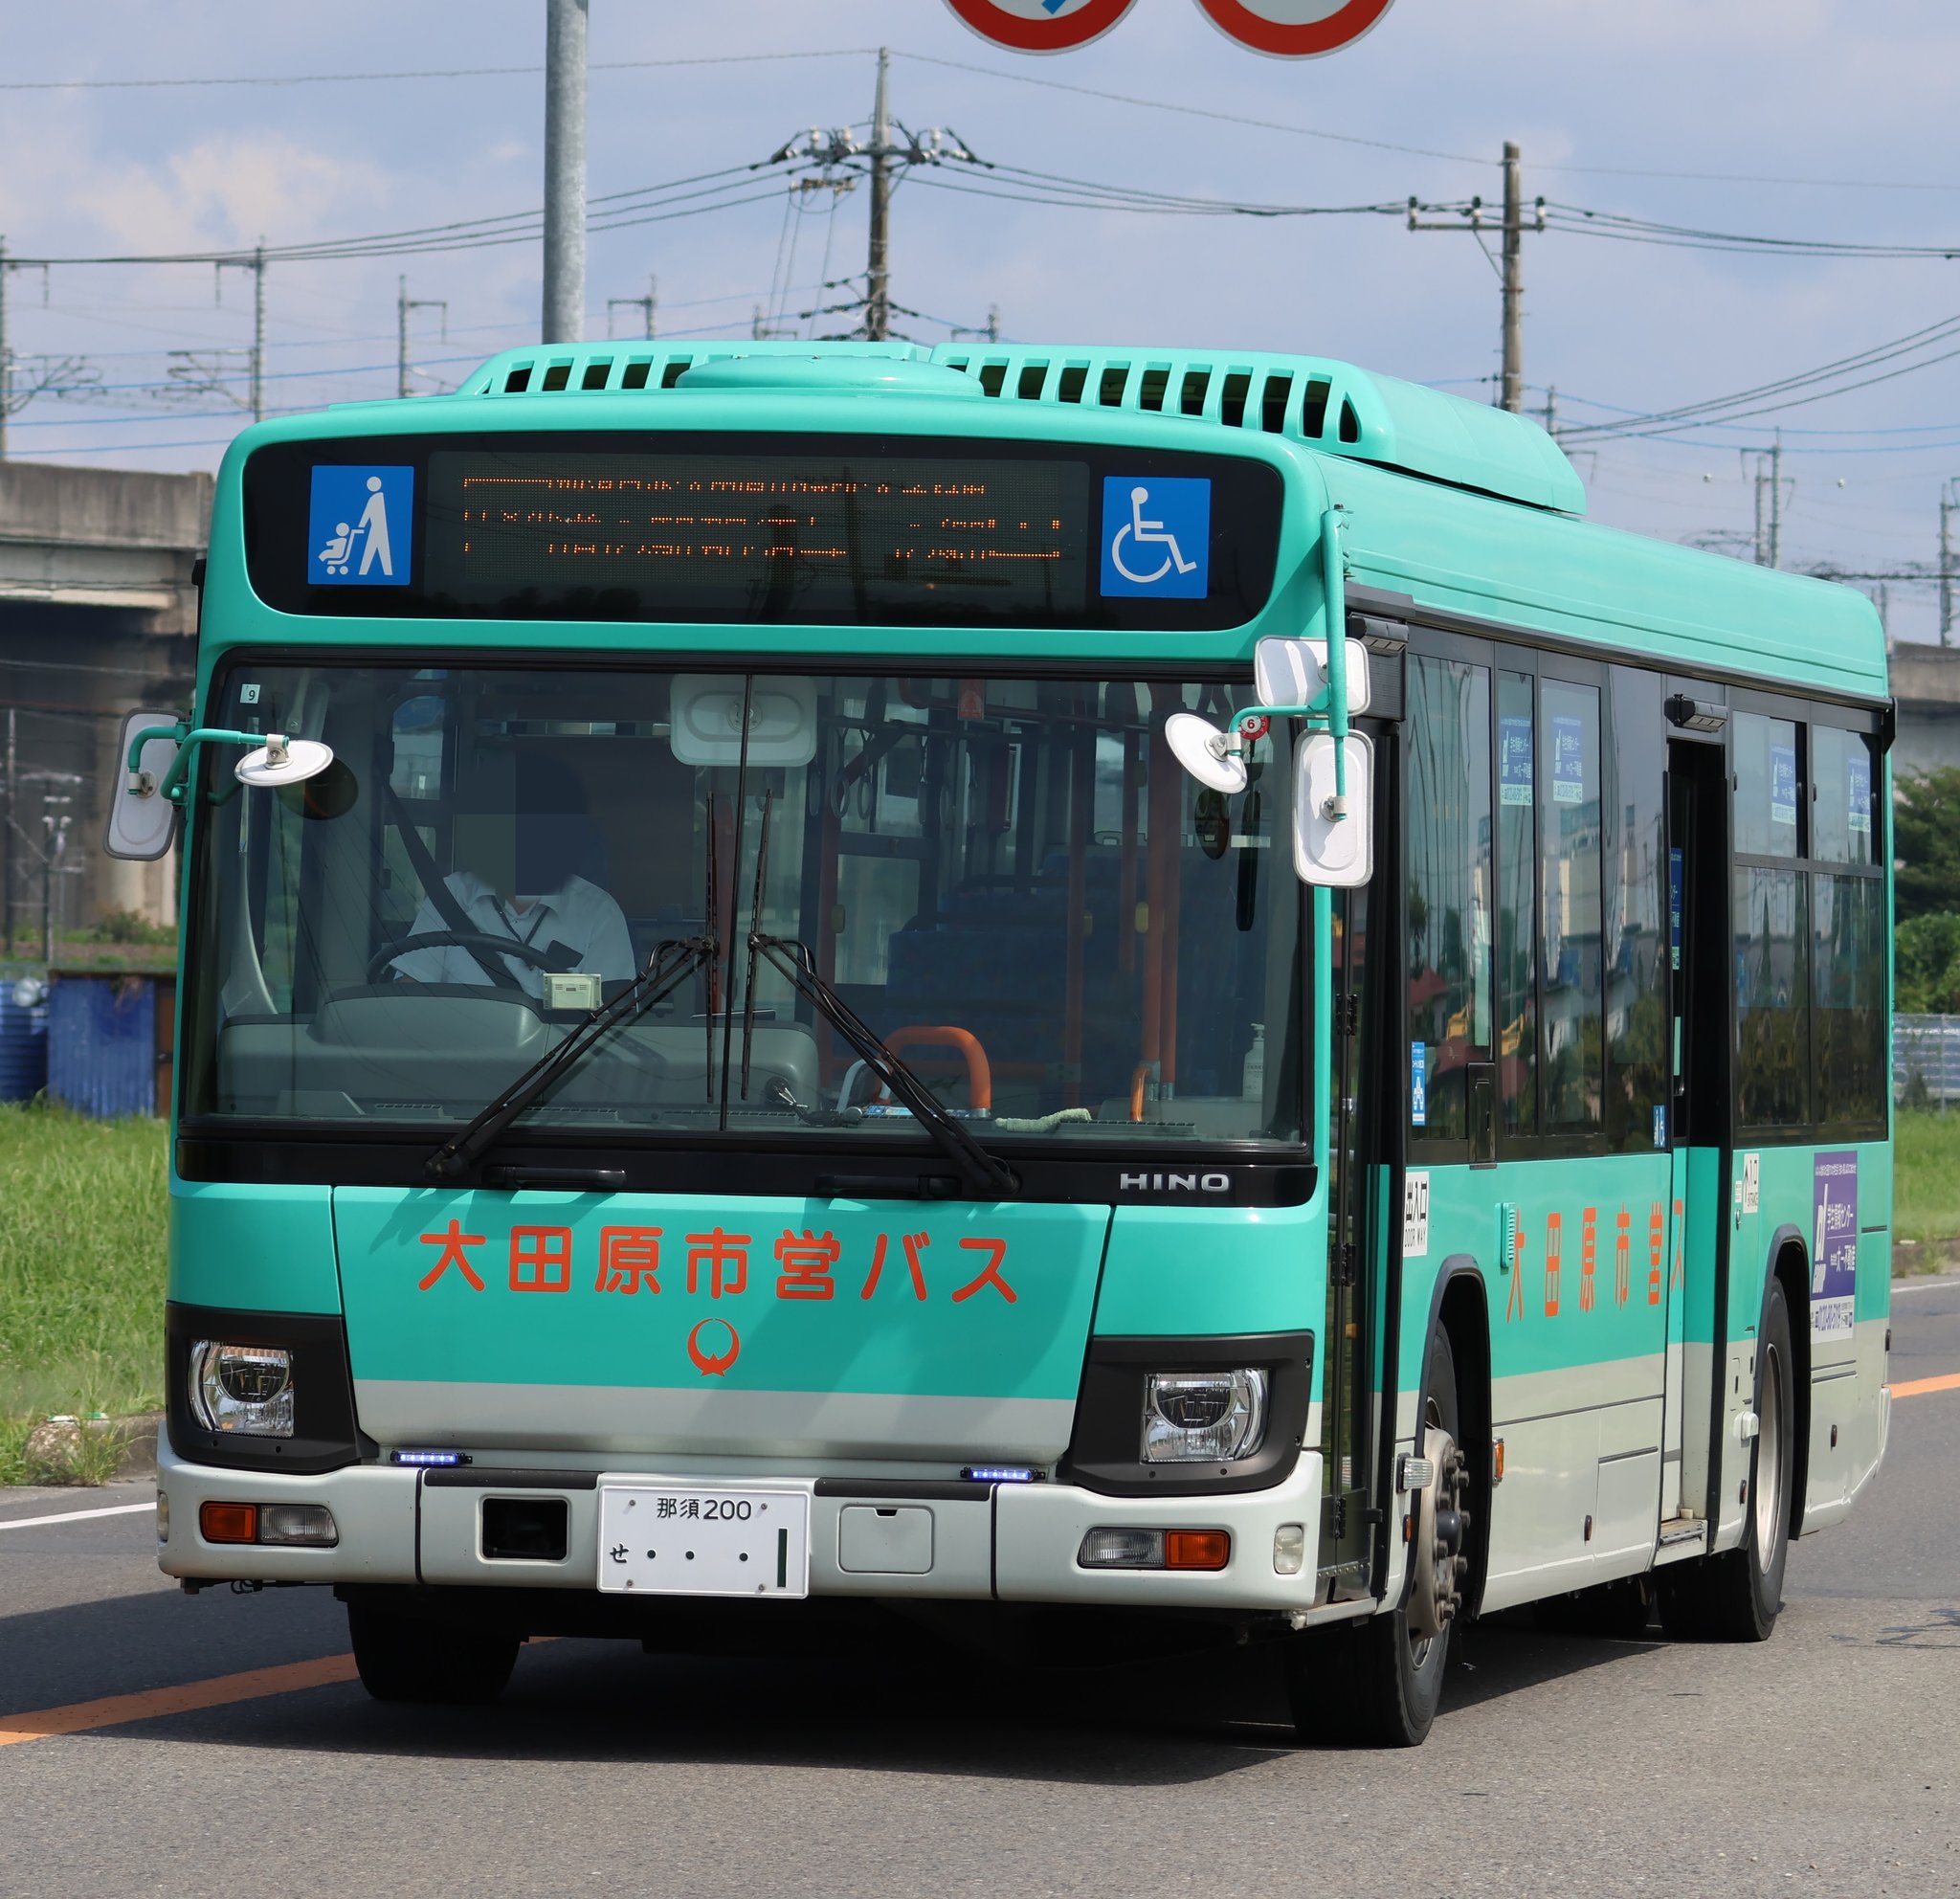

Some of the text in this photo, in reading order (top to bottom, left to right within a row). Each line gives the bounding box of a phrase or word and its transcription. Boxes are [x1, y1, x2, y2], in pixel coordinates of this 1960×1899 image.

[248, 689, 256, 701] 9
[1247, 719, 1256, 729] 6
[1120, 1173, 1230, 1193] HINO
[1405, 1180, 1427, 1223] 出入口
[1404, 1226, 1426, 1248] DOOR WAY
[418, 1219, 1018, 1305] 大田原市営バス
[609, 1543, 630, 1564] せ
